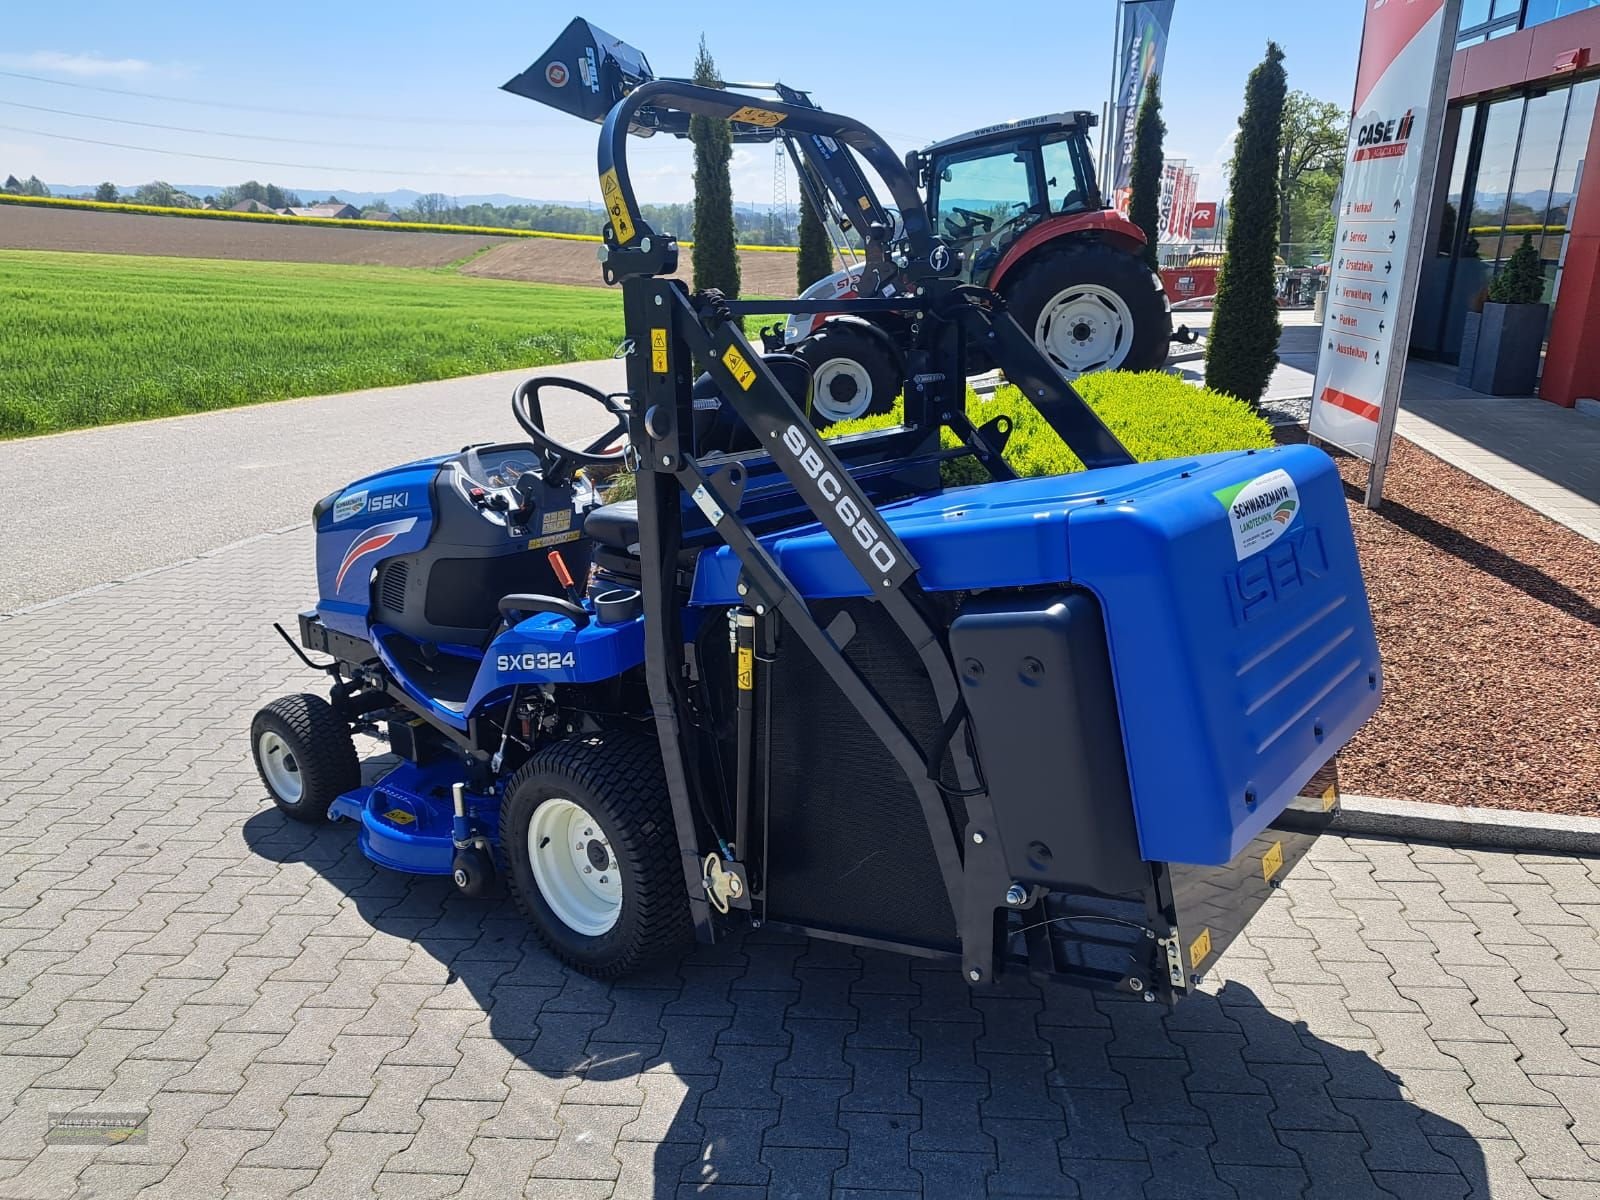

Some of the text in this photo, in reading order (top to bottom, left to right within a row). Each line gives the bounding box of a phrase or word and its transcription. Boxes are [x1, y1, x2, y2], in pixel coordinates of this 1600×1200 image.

[1122, 36, 1142, 164] SCHWARZMAYR
[1358, 119, 1396, 146] CASE
[1354, 202, 1373, 213] Verkauf
[1350, 232, 1368, 243] Service
[1345, 259, 1374, 273] Ersatzteile
[1343, 287, 1372, 303] Verwaltung
[1339, 314, 1358, 327] Parken
[1336, 343, 1368, 362] Ausstellung
[367, 491, 409, 513] ISEKI
[782, 424, 896, 573] SBC650
[1233, 486, 1289, 520] SCHWARZMAYR
[1240, 511, 1273, 534] LANDTECHNIK
[1222, 525, 1329, 631] ISEKI
[497, 652, 576, 671] SXG324
